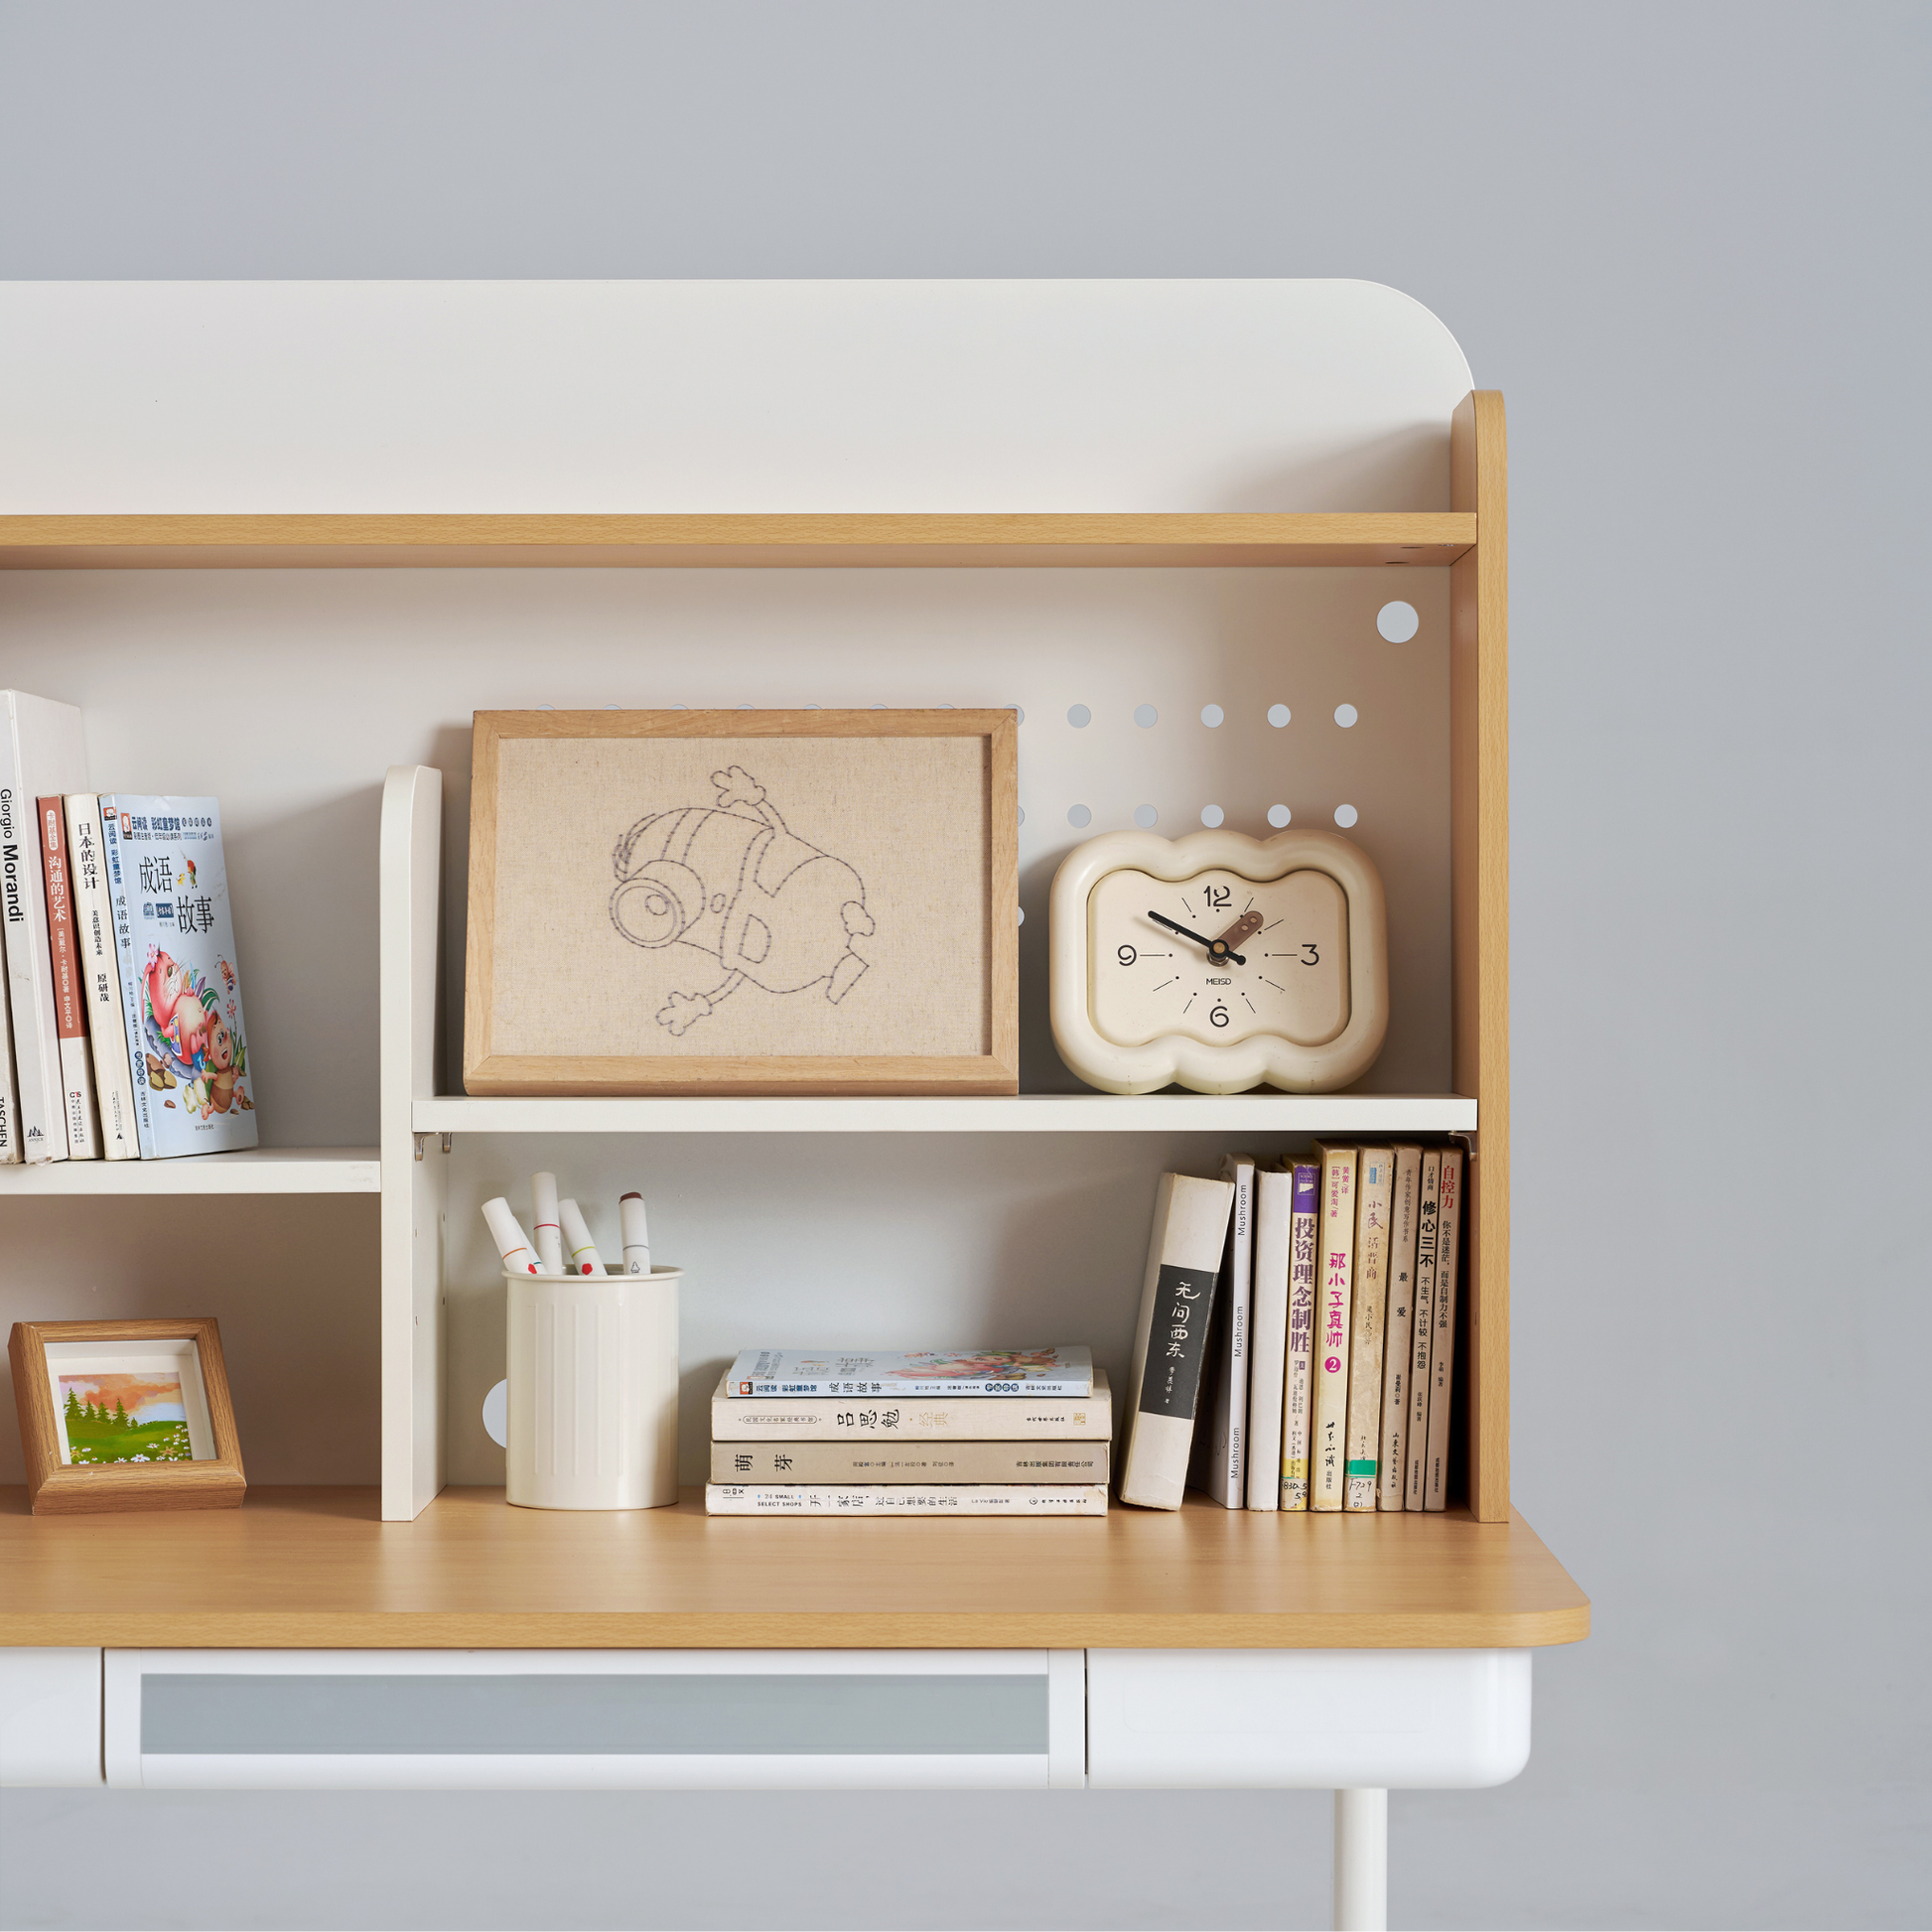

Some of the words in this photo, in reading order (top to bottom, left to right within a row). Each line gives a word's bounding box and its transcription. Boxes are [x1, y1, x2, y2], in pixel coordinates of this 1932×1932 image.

[0, 788, 15, 839] Giorgio
[78, 822, 100, 890] 日本的设计
[138, 855, 173, 895] 成语
[3, 844, 24, 922] Morandi
[48, 856, 67, 922] 沟通的艺术
[1203, 886, 1232, 907] 12
[116, 896, 131, 948] 成语故事
[176, 895, 214, 934] 故事
[1118, 944, 1137, 966] 9
[1301, 943, 1319, 966] 3
[97, 973, 110, 1002] 原研哉
[1209, 1006, 1229, 1028] 6
[1441, 1166, 1455, 1209] 自控力
[1237, 1184, 1247, 1236] Mushroom
[1367, 1200, 1384, 1230] 小民
[1420, 1200, 1438, 1268] 修心三不
[1290, 1217, 1315, 1353] 投资理念制胜
[1325, 1252, 1346, 1348] 那小子真帅
[1397, 1272, 1409, 1317] 最爱
[1166, 1281, 1201, 1358] 无问西东
[1234, 1306, 1244, 1357] Mushroom
[1418, 1309, 1429, 1337] 不计较
[1328, 1358, 1338, 1371] 2
[1416, 1341, 1428, 1370] 不抱怨
[828, 1382, 883, 1393] 成语故事
[837, 1409, 900, 1430] 吕思勉
[918, 1412, 949, 1428] 经典
[735, 1454, 793, 1472] 萌芽
[1230, 1427, 1240, 1479] Mushroom
[1391, 1433, 1400, 1489] 山东文艺出版社
